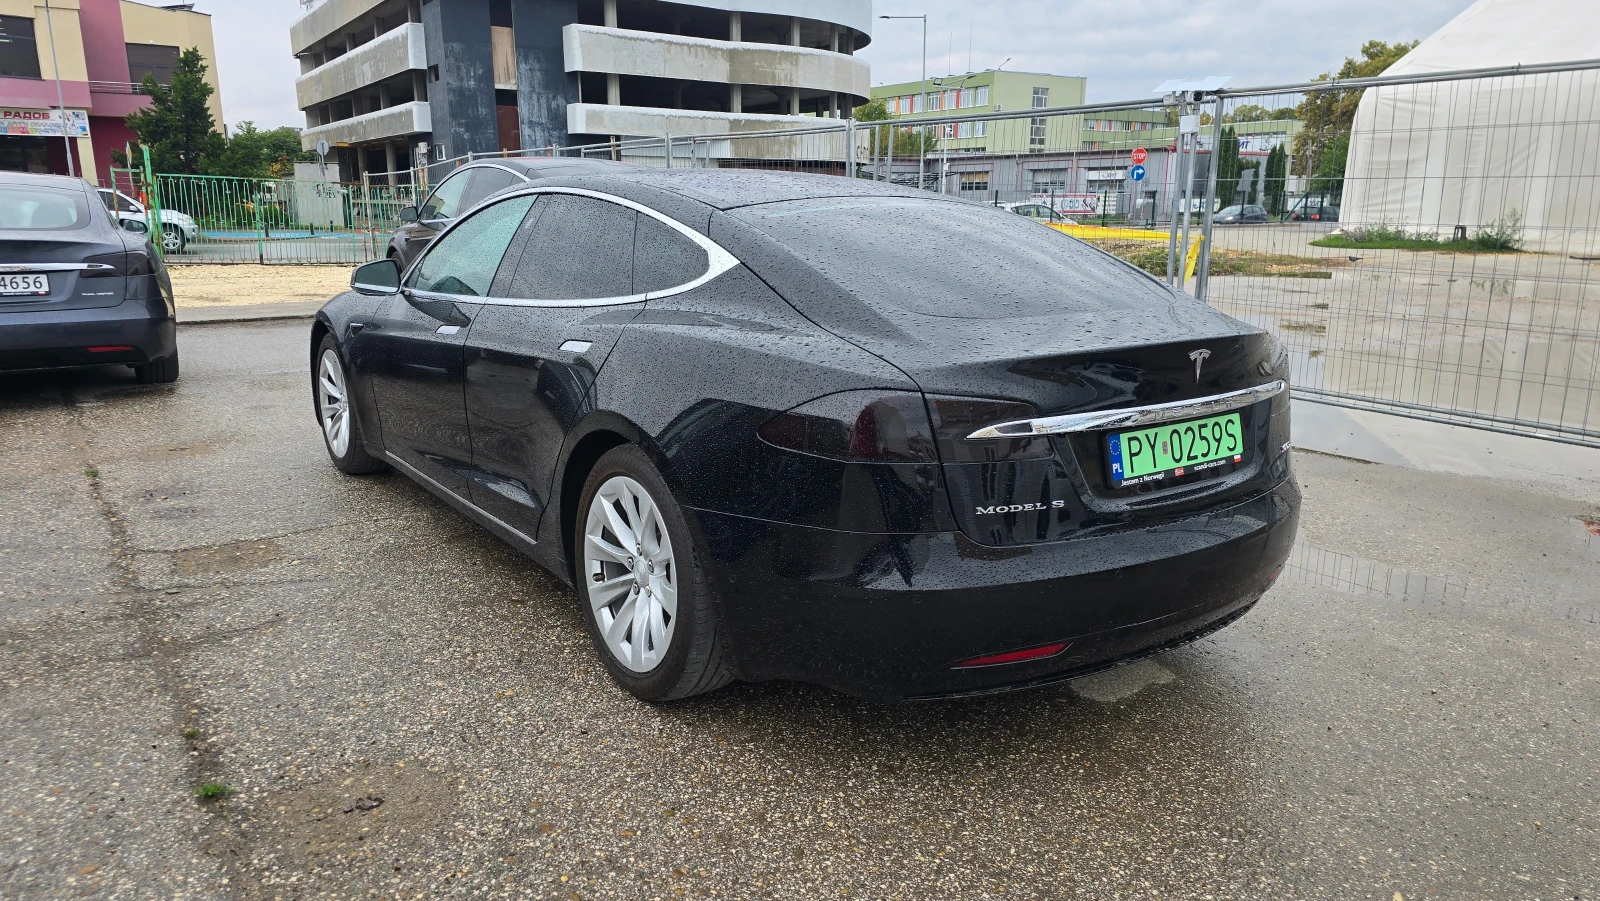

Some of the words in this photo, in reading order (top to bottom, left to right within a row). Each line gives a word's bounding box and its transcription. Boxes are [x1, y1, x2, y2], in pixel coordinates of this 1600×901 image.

[4, 111, 50, 120] РАДОБ
[1127, 431, 1159, 473] PY
[1169, 418, 1237, 463] 0259S
[1112, 463, 1123, 474] PL
[1120, 478, 1139, 487] Jestem
[1143, 472, 1165, 482] Norwegii
[975, 502, 1047, 515] MODEL
[1051, 500, 1065, 509] S
